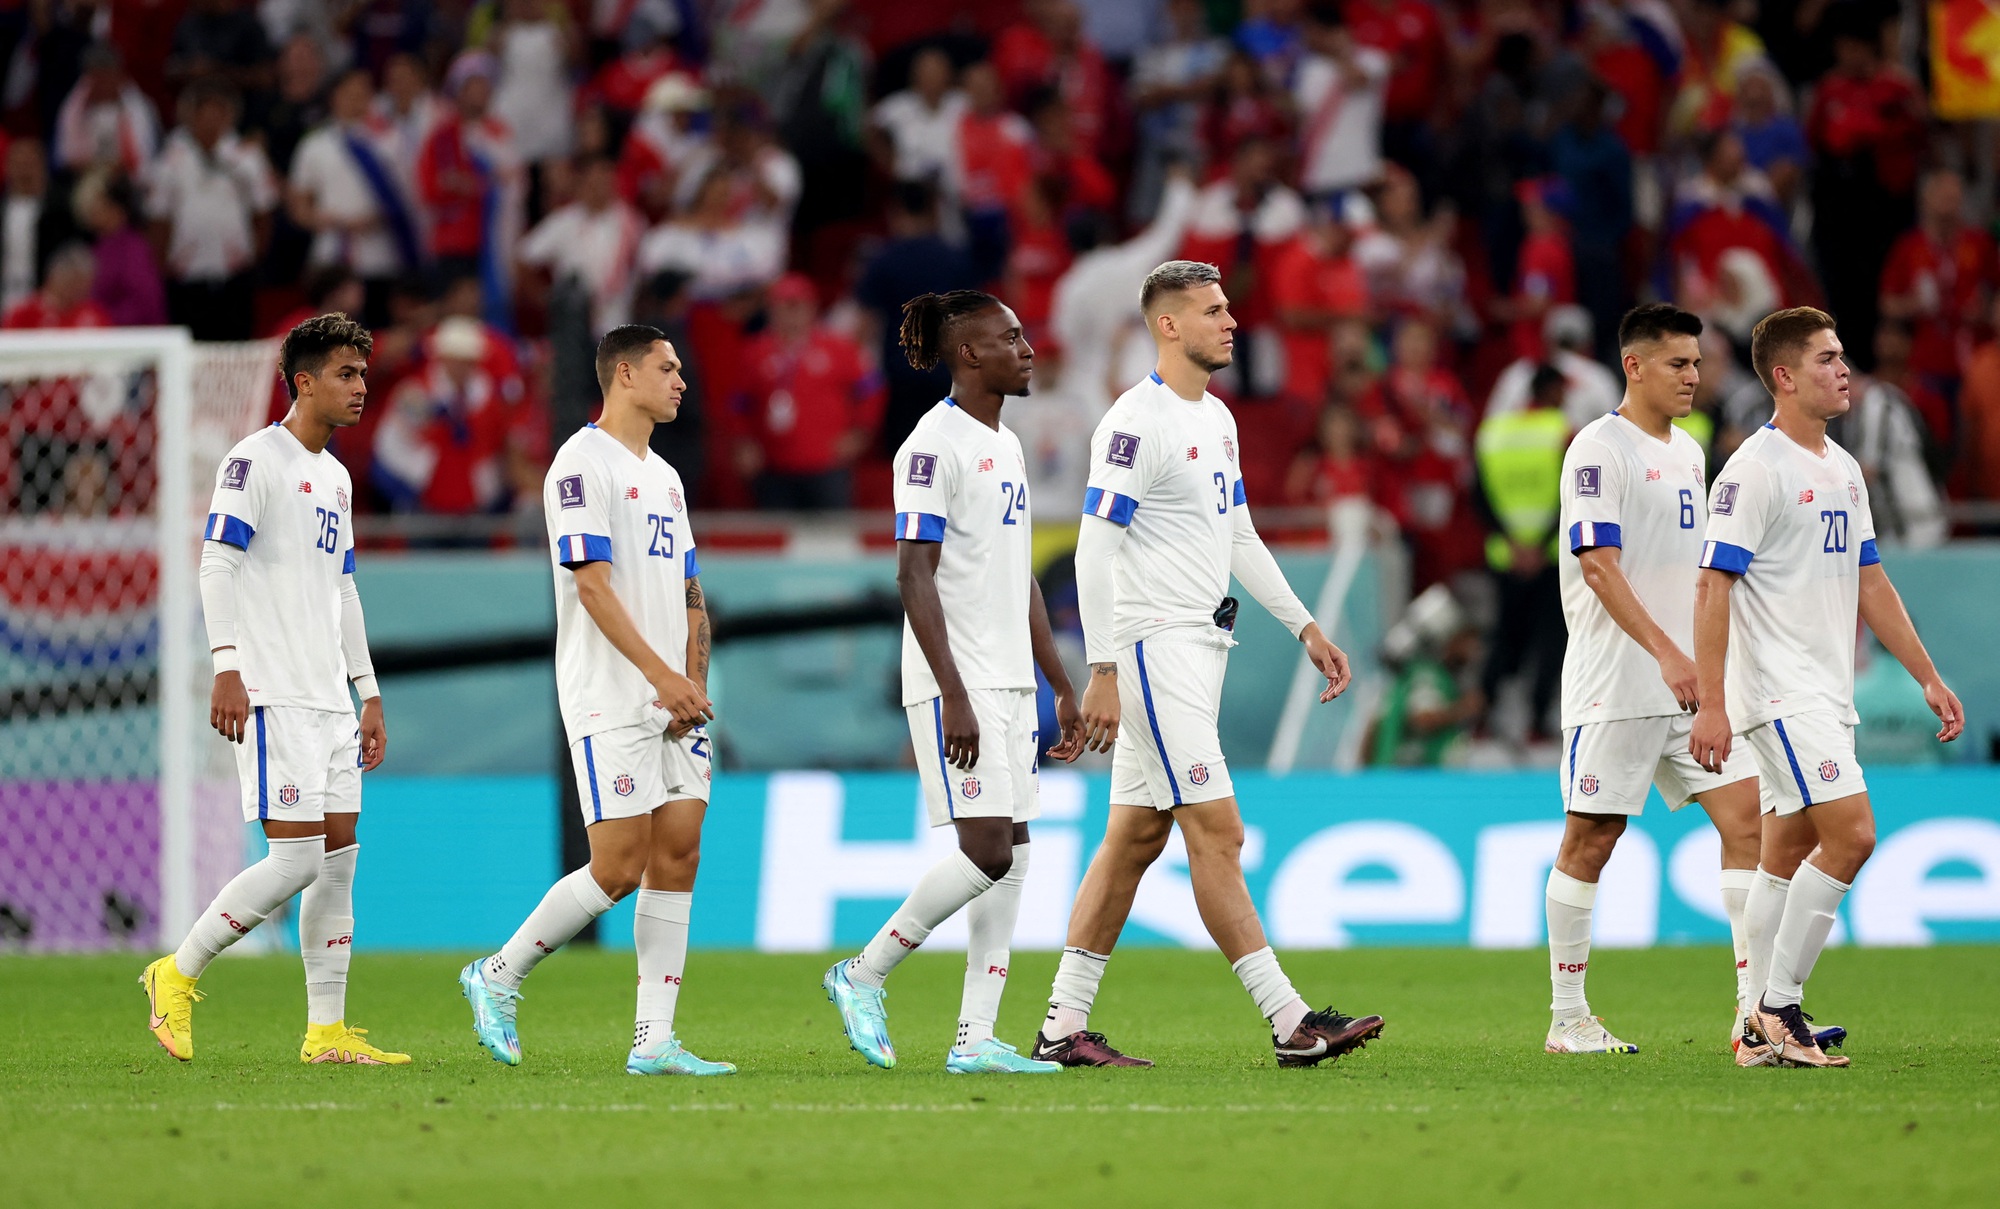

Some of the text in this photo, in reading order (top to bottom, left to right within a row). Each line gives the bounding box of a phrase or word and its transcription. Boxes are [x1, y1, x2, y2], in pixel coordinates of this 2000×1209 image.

[1001, 481, 1026, 526] 24
[1213, 471, 1227, 515] 3
[1679, 489, 1695, 529] 6
[316, 506, 339, 554] 26
[648, 513, 673, 559] 25
[1821, 510, 1848, 553] 20
[1192, 767, 1206, 782] CR
[1584, 778, 1596, 792] CR
[1822, 763, 1836, 779] CR
[283, 788, 296, 802] CR
[618, 778, 631, 793] CR
[965, 780, 978, 795] CR
